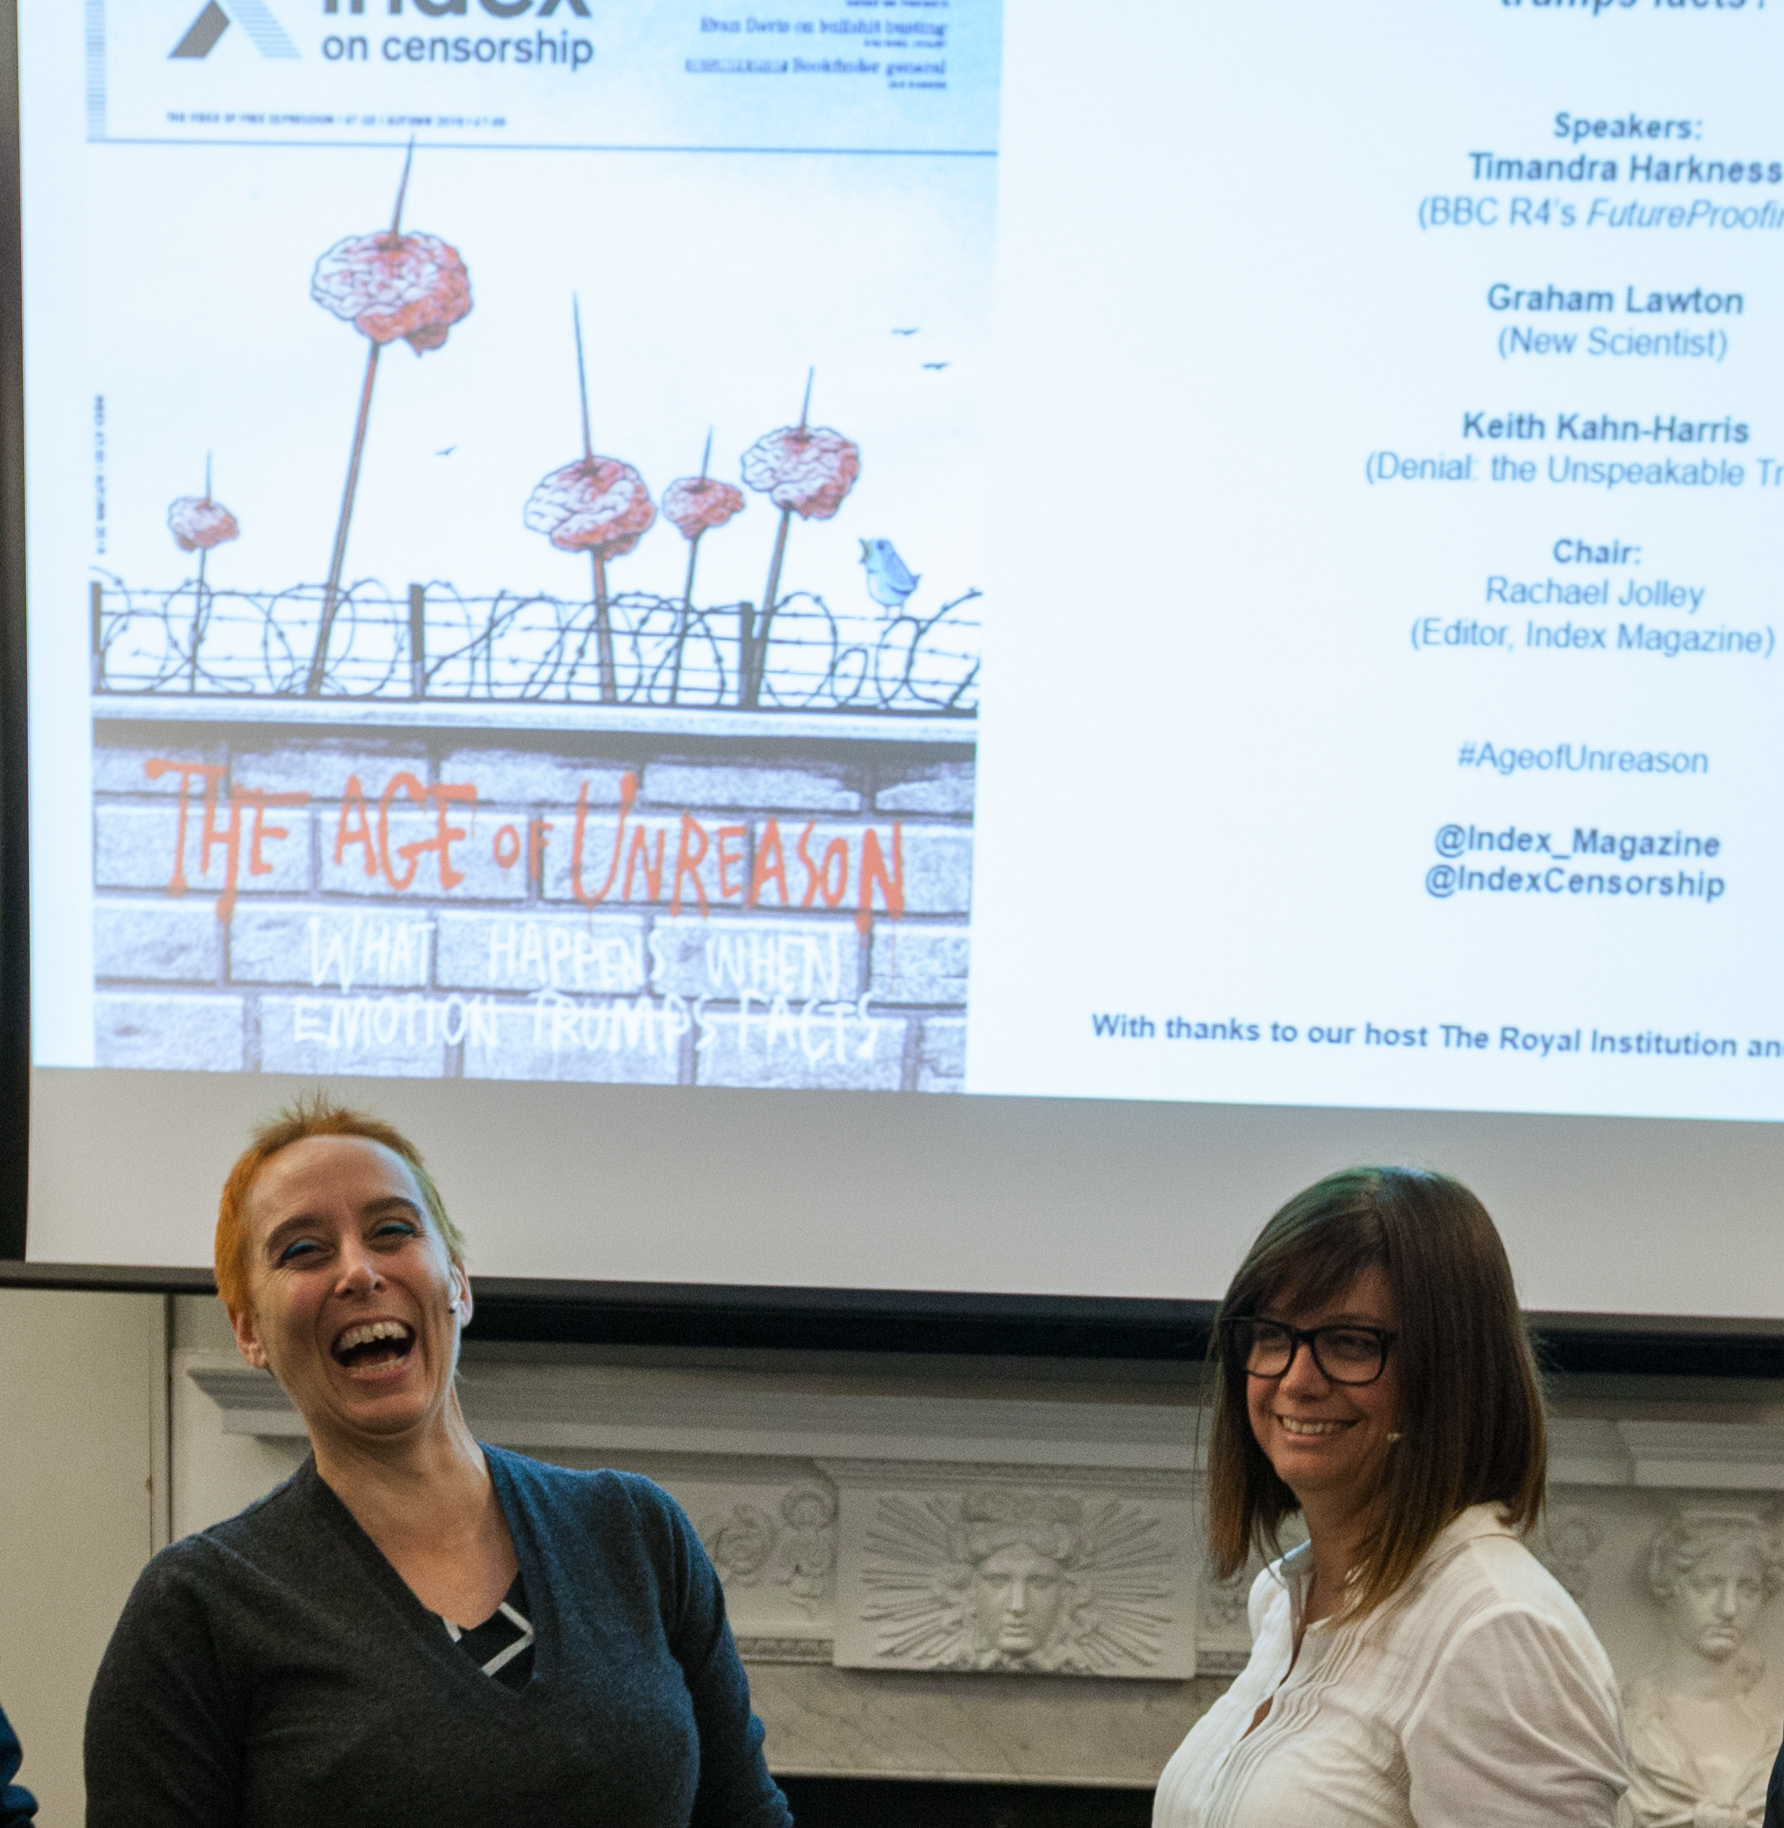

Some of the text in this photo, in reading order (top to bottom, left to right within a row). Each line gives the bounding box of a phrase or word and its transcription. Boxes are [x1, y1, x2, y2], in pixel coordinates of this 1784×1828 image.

[320, 27, 596, 74] on censorship
[1553, 110, 1703, 146] Speakers:
[1467, 150, 1784, 186] Timandra Harkness
[1417, 194, 1499, 231] (BBC
[1508, 195, 1578, 228] R4's
[1486, 281, 1745, 316] Graham Lawton
[1497, 325, 1729, 363] (New Scientist)
[1462, 411, 1751, 445] Keith Kahn-Harris
[1364, 450, 1477, 486] (Denial:
[1490, 453, 1538, 484] the
[1547, 454, 1747, 491] Unspeakable
[1551, 537, 1642, 566] Chair:
[1485, 574, 1706, 616] Rachael Jolley
[1409, 616, 1777, 660] (Editor, Index Magazine)
[1457, 740, 1710, 777] #AgeofUnreason
[144, 757, 312, 924] THE
[334, 771, 478, 892] AGE
[571, 770, 906, 936] UNREASON
[1433, 823, 1722, 862] @Index_Magazine
[1424, 860, 1727, 905] @IndexCensorship
[308, 912, 840, 1002] WHAT HAPPENS WHEN
[294, 988, 880, 1066] EMOTION TRUMPS FACTS
[1091, 1012, 1157, 1039] With
[1164, 1015, 1262, 1043] thanks
[1269, 1020, 1300, 1044] to
[1306, 1025, 1357, 1046] our
[1363, 1021, 1430, 1049] host
[1438, 1023, 1491, 1051] The
[1498, 1025, 1583, 1059] Royal
[1590, 1028, 1739, 1058] Institution
